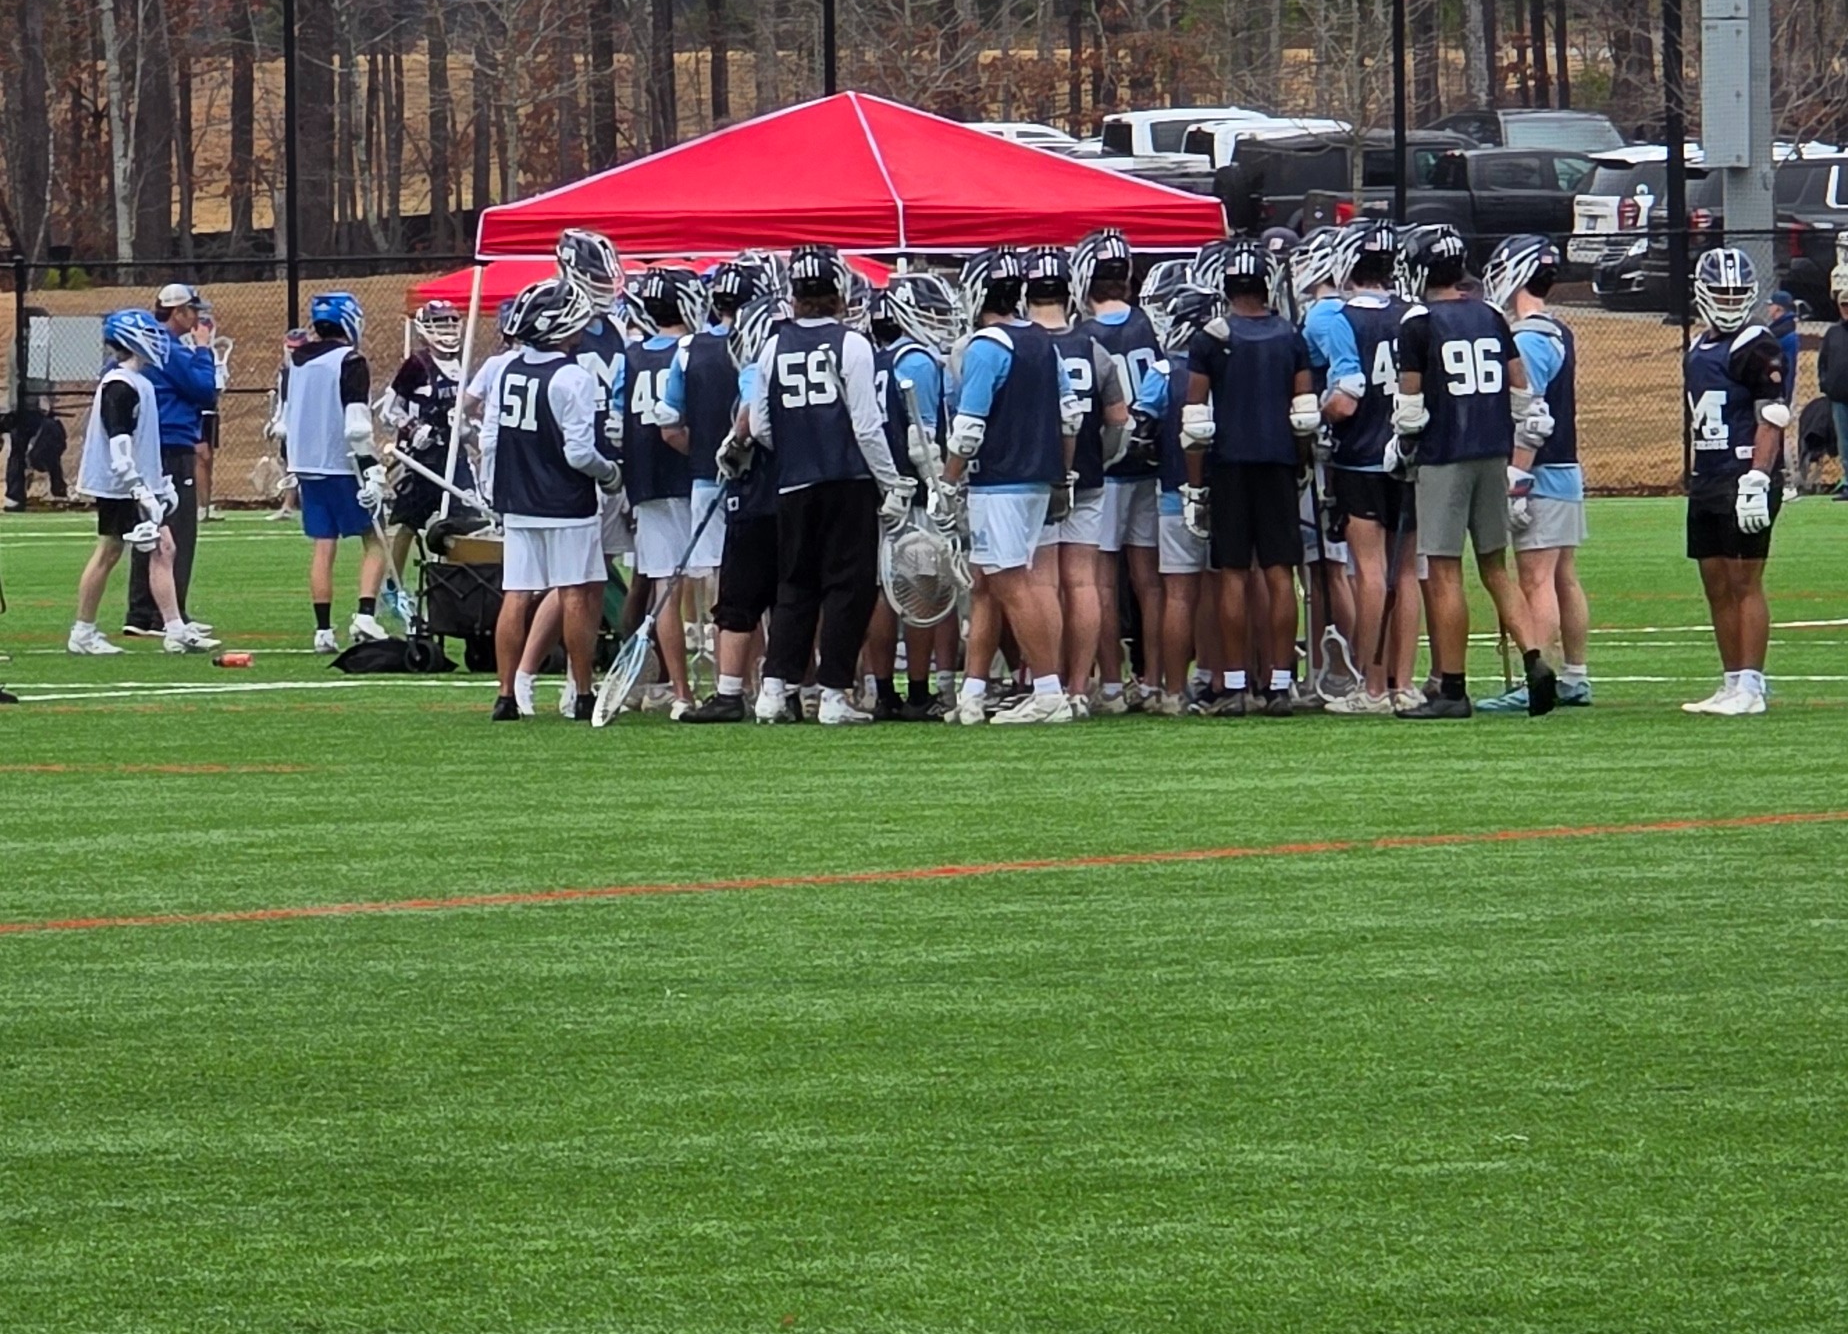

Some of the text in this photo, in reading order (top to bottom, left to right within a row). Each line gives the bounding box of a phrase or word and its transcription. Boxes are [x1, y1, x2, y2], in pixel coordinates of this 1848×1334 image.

[777, 350, 838, 408] 59
[1371, 339, 1399, 395] 4
[1442, 338, 1502, 396] 96
[499, 373, 540, 432] 51
